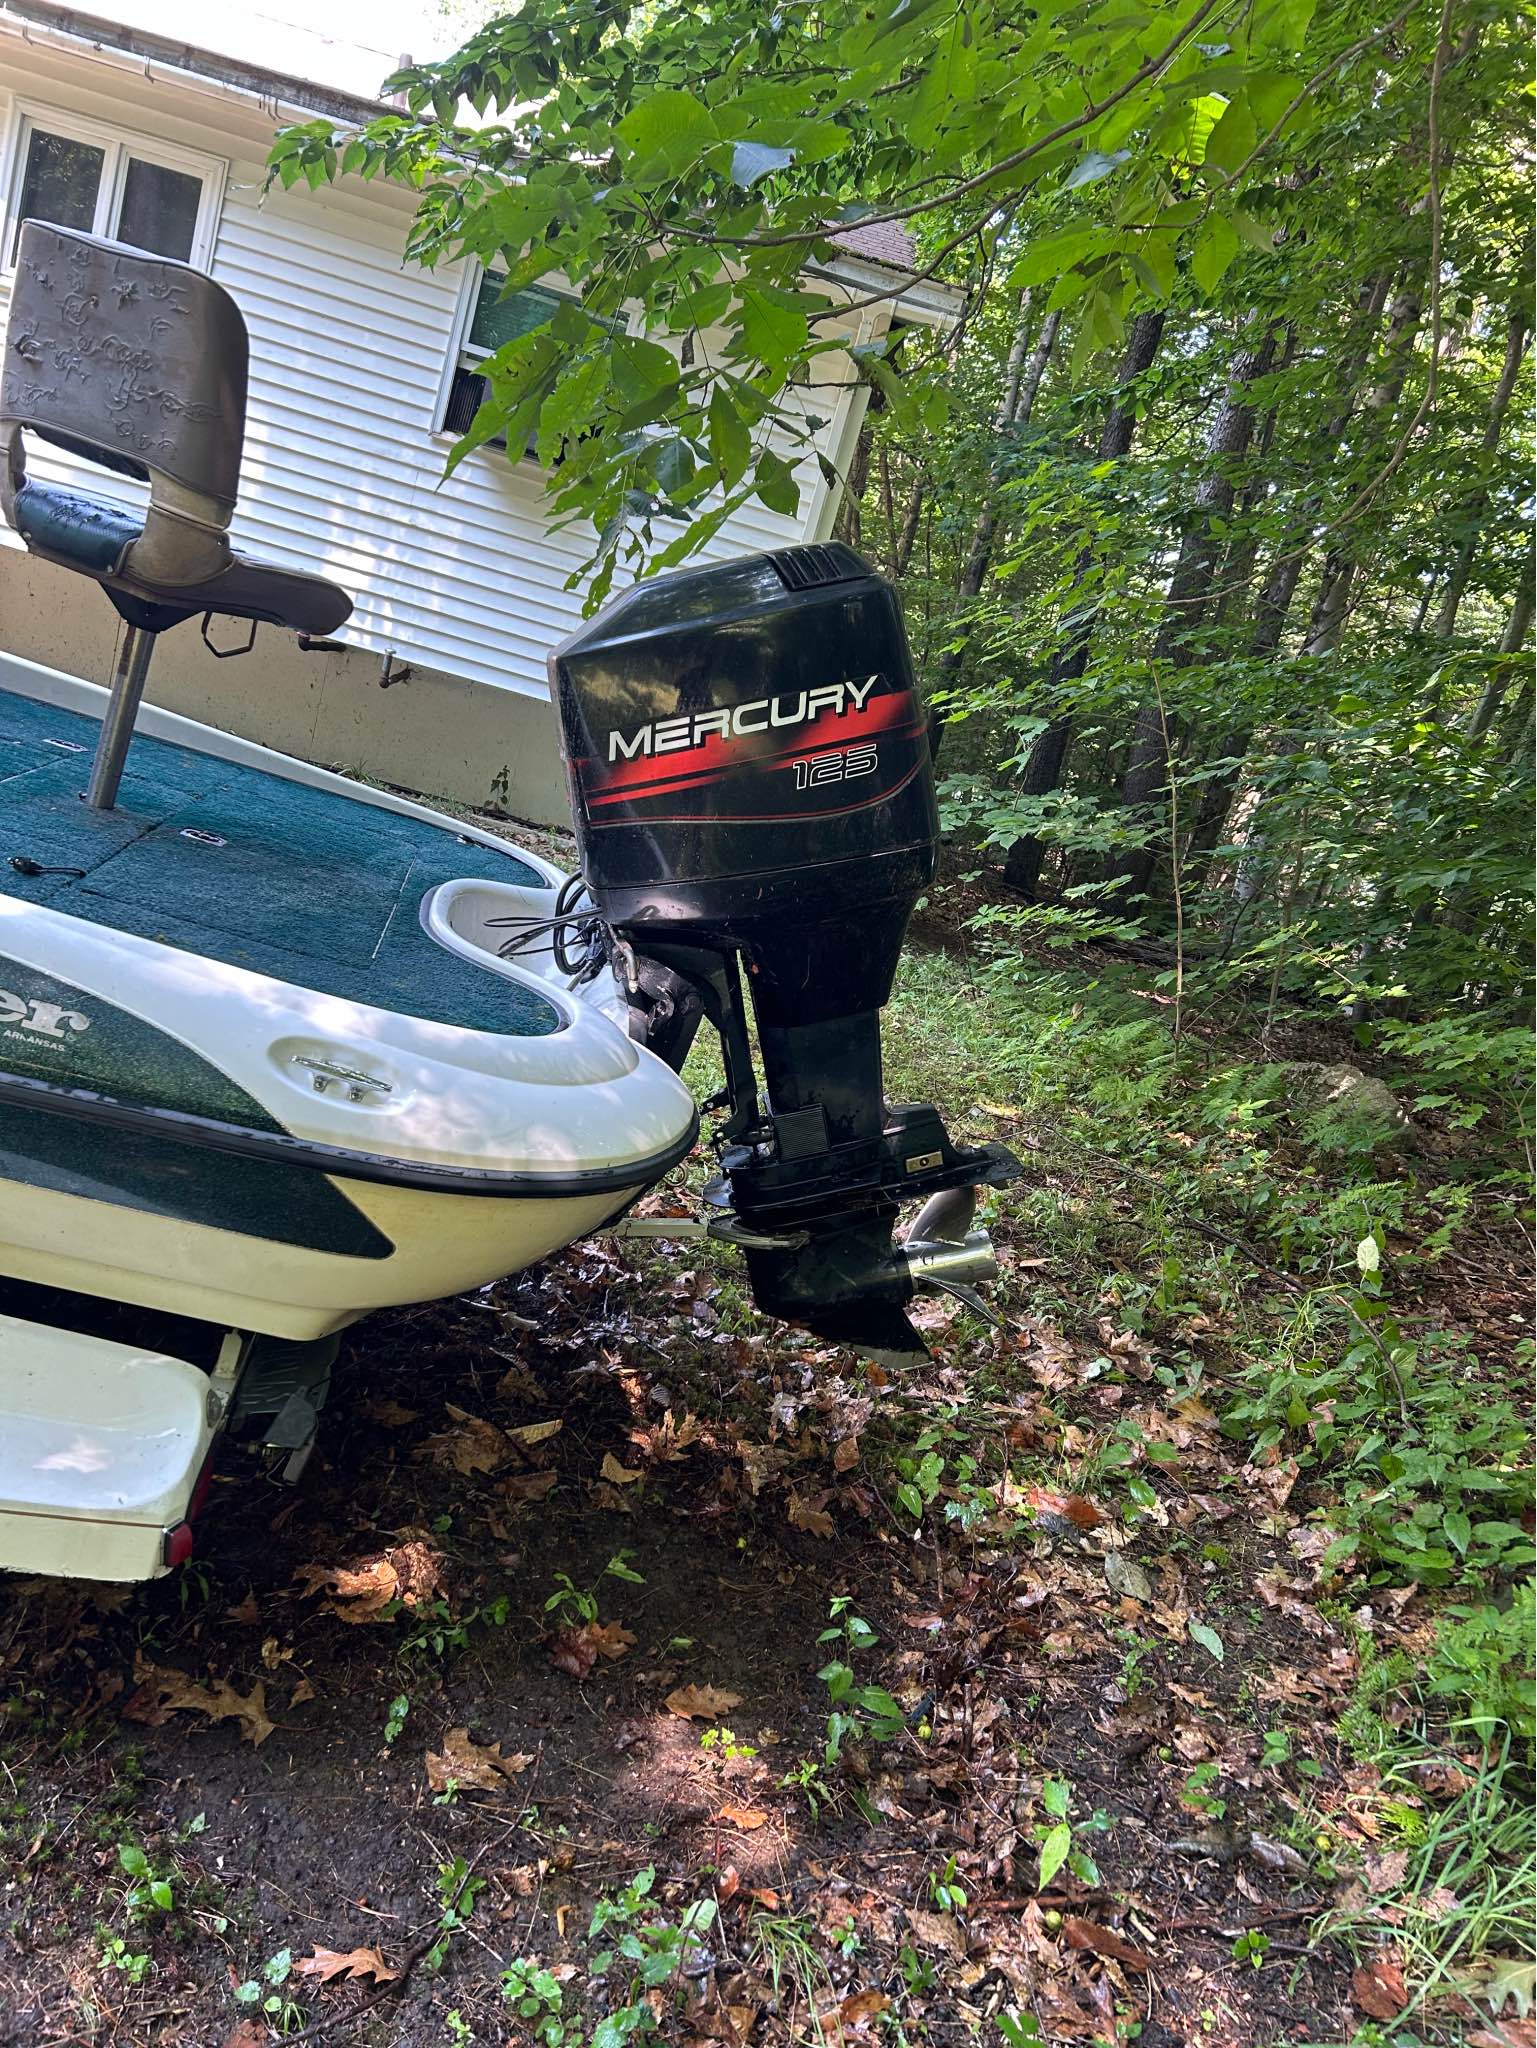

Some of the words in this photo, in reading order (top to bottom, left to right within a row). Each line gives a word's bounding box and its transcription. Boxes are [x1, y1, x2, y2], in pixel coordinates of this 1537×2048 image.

[608, 675, 878, 761] MERCURY
[793, 743, 878, 789] 125
[4, 1030, 65, 1051] ARKANSAS
